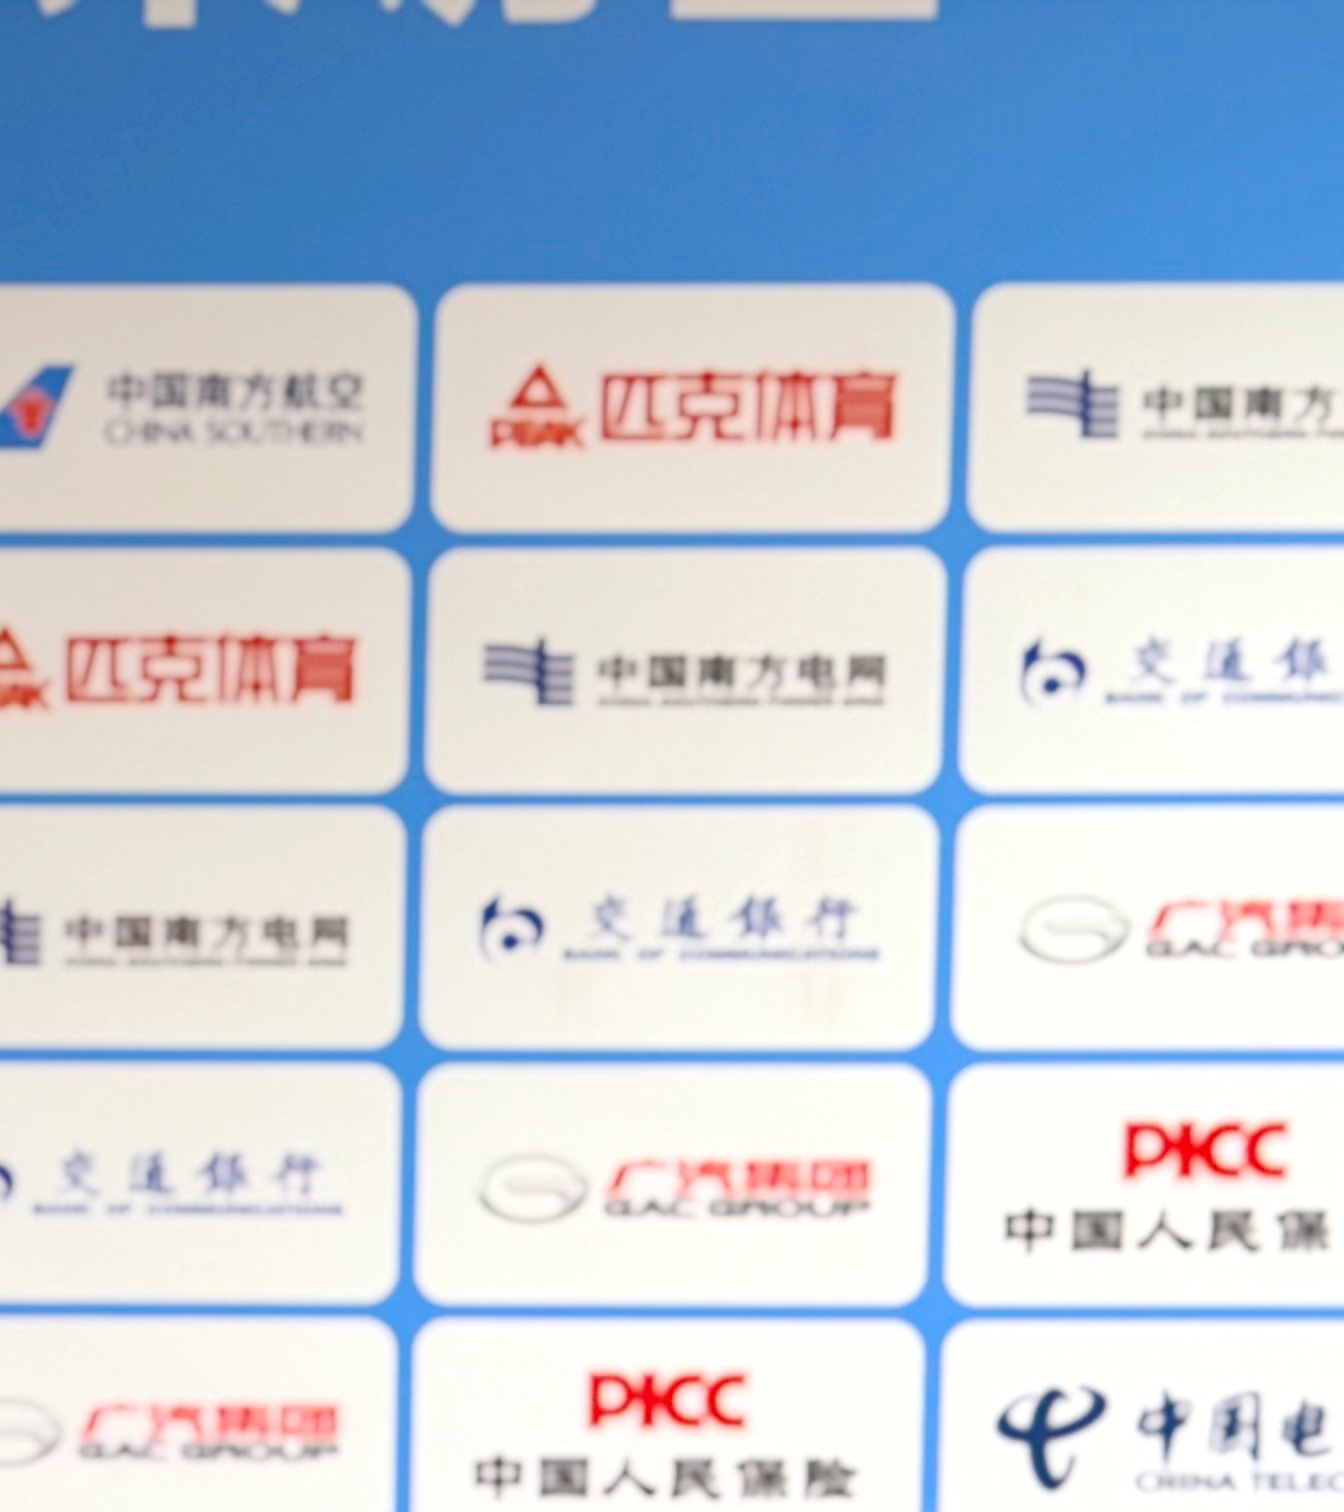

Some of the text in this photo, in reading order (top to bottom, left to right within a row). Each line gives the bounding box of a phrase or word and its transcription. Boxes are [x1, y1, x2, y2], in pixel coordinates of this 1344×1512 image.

[107, 372, 362, 409] 中国南方航空
[602, 370, 895, 441] 匹克体育
[68, 634, 354, 703] 匹克体育
[1146, 938, 1237, 957] GAC
[1123, 1120, 1287, 1180] PICC
[604, 1198, 868, 1217] GAC GROUP
[588, 1372, 746, 1429] PICC
[78, 1441, 337, 1460] GAC GROUP
[473, 1452, 856, 1503] 中国人民保险
